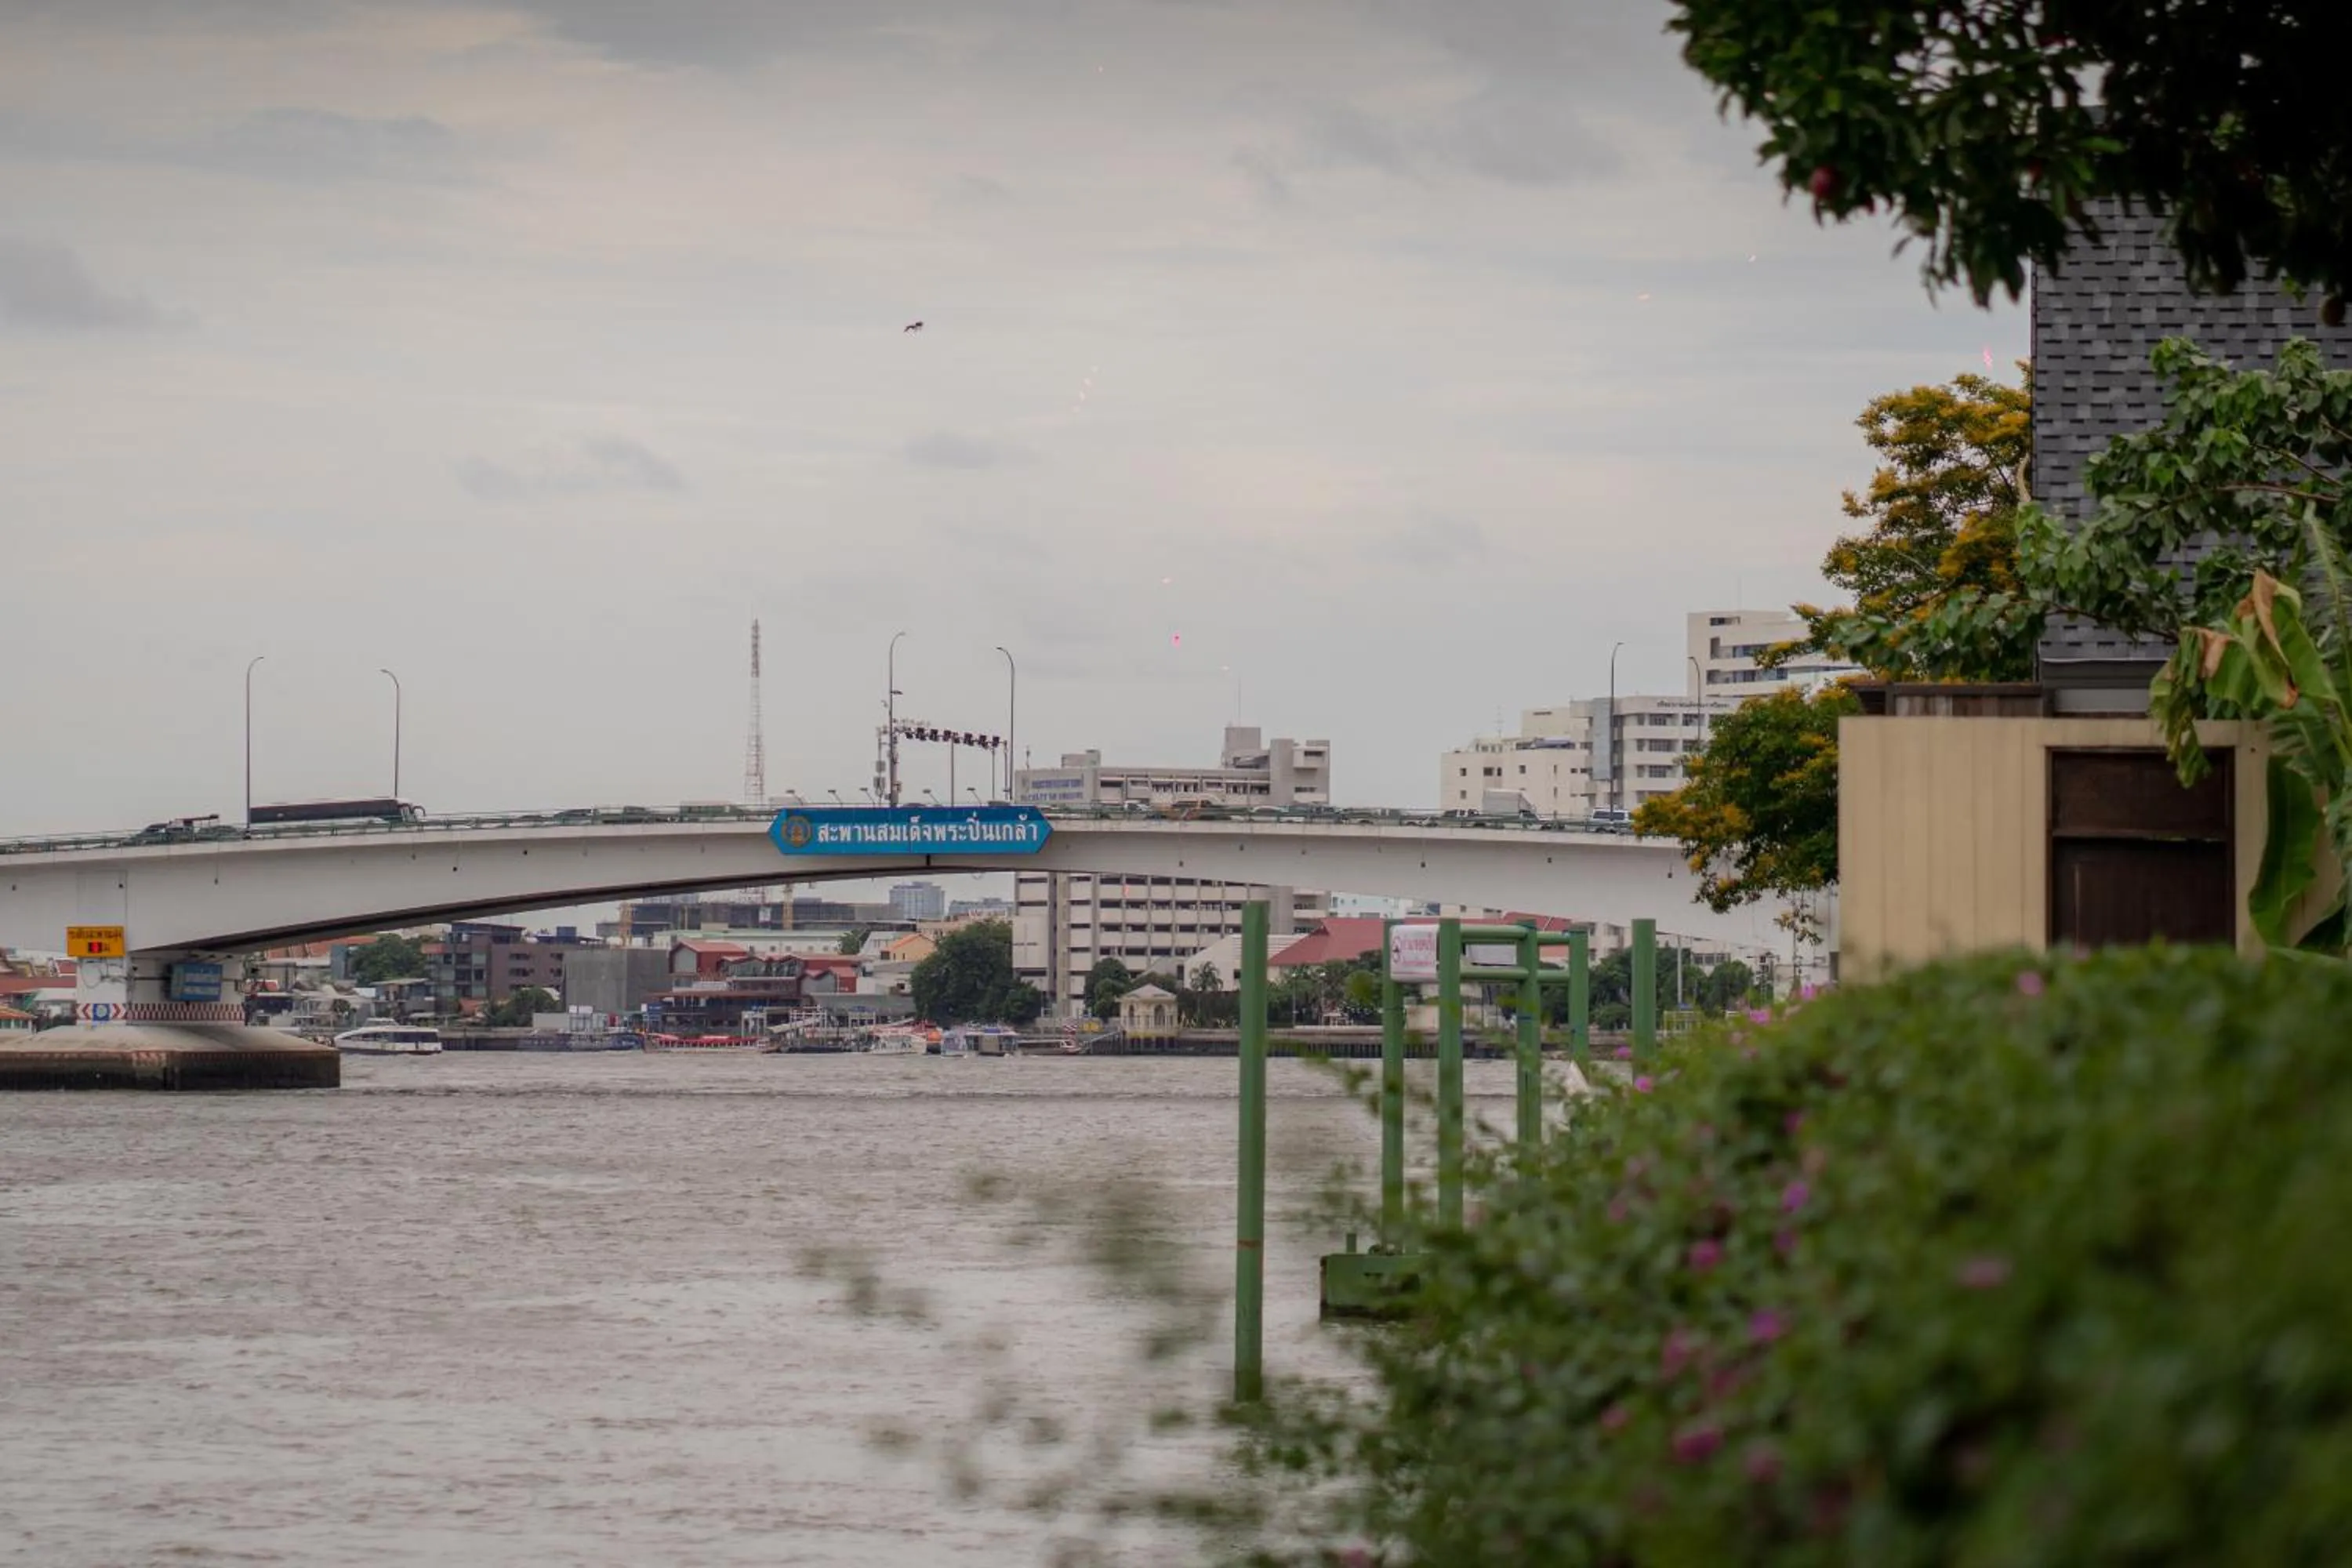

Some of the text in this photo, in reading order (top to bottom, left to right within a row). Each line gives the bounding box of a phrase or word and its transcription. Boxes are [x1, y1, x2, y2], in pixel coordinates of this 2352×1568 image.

[818, 810, 1038, 842] สะพานสมเด็จพระปิ่นเกล้า
